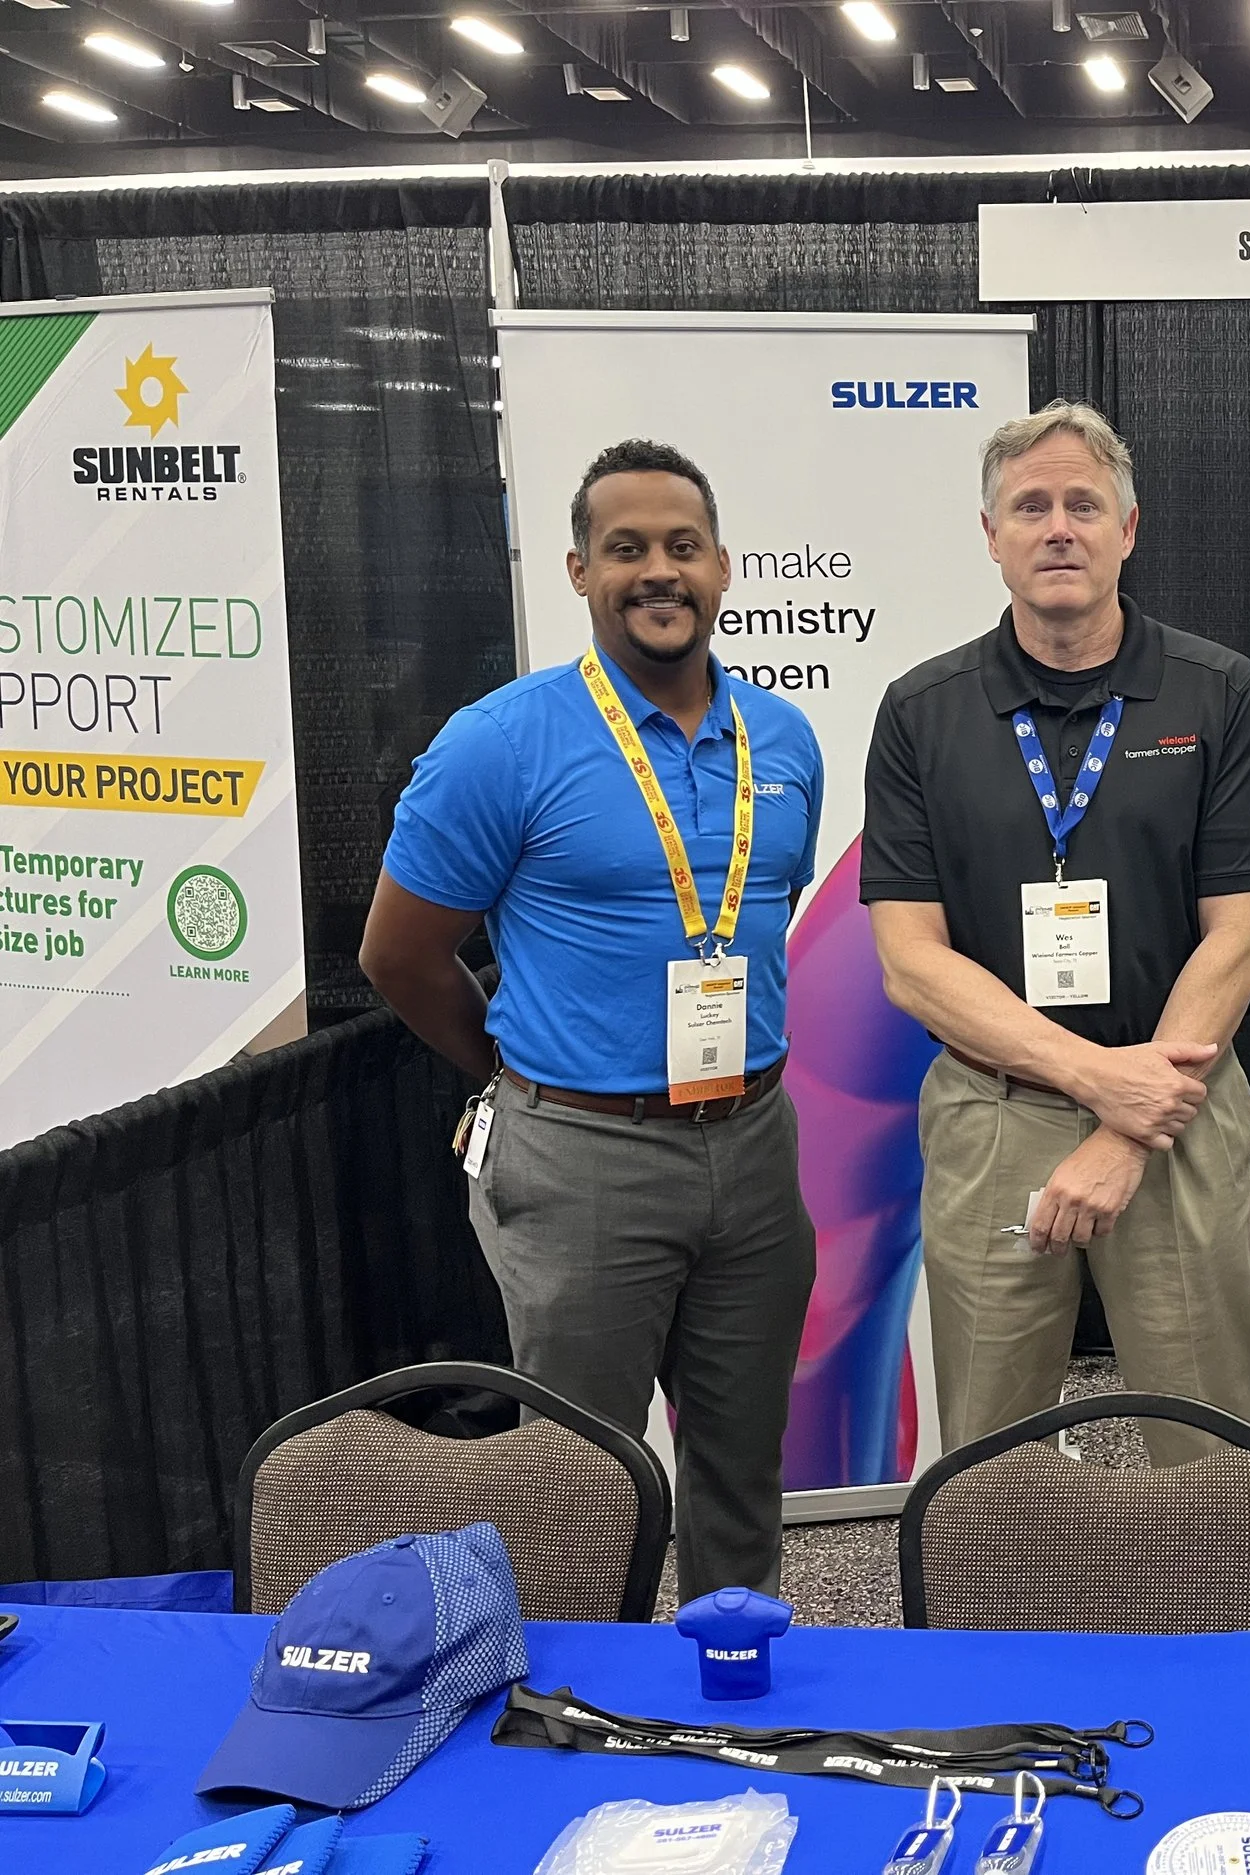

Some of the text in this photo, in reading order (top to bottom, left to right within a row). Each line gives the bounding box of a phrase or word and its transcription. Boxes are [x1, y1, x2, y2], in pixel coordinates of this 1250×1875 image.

[831, 381, 980, 409] SULZER
[73, 446, 241, 484] SUNBELT
[97, 486, 218, 502] RENTALS
[742, 543, 852, 579] make
[711, 600, 877, 643] emistry
[604, 705, 622, 722] 3S
[1158, 734, 1197, 746] wieland
[1161, 744, 1197, 755] copper
[631, 756, 648, 774] 3S
[3, 760, 245, 807] YOUR PROJECT
[655, 811, 669, 829] 3S
[0, 845, 144, 888] Temporary
[78, 889, 118, 920] for
[0, 924, 85, 962] ize job
[169, 965, 250, 983] LEARN MORE
[280, 1645, 372, 1674] SULZER
[705, 1648, 758, 1661] SULZER
[0, 1761, 59, 1777] ULZER
[823, 1756, 884, 1776] SULZER
[653, 1823, 723, 1838] SULZER
